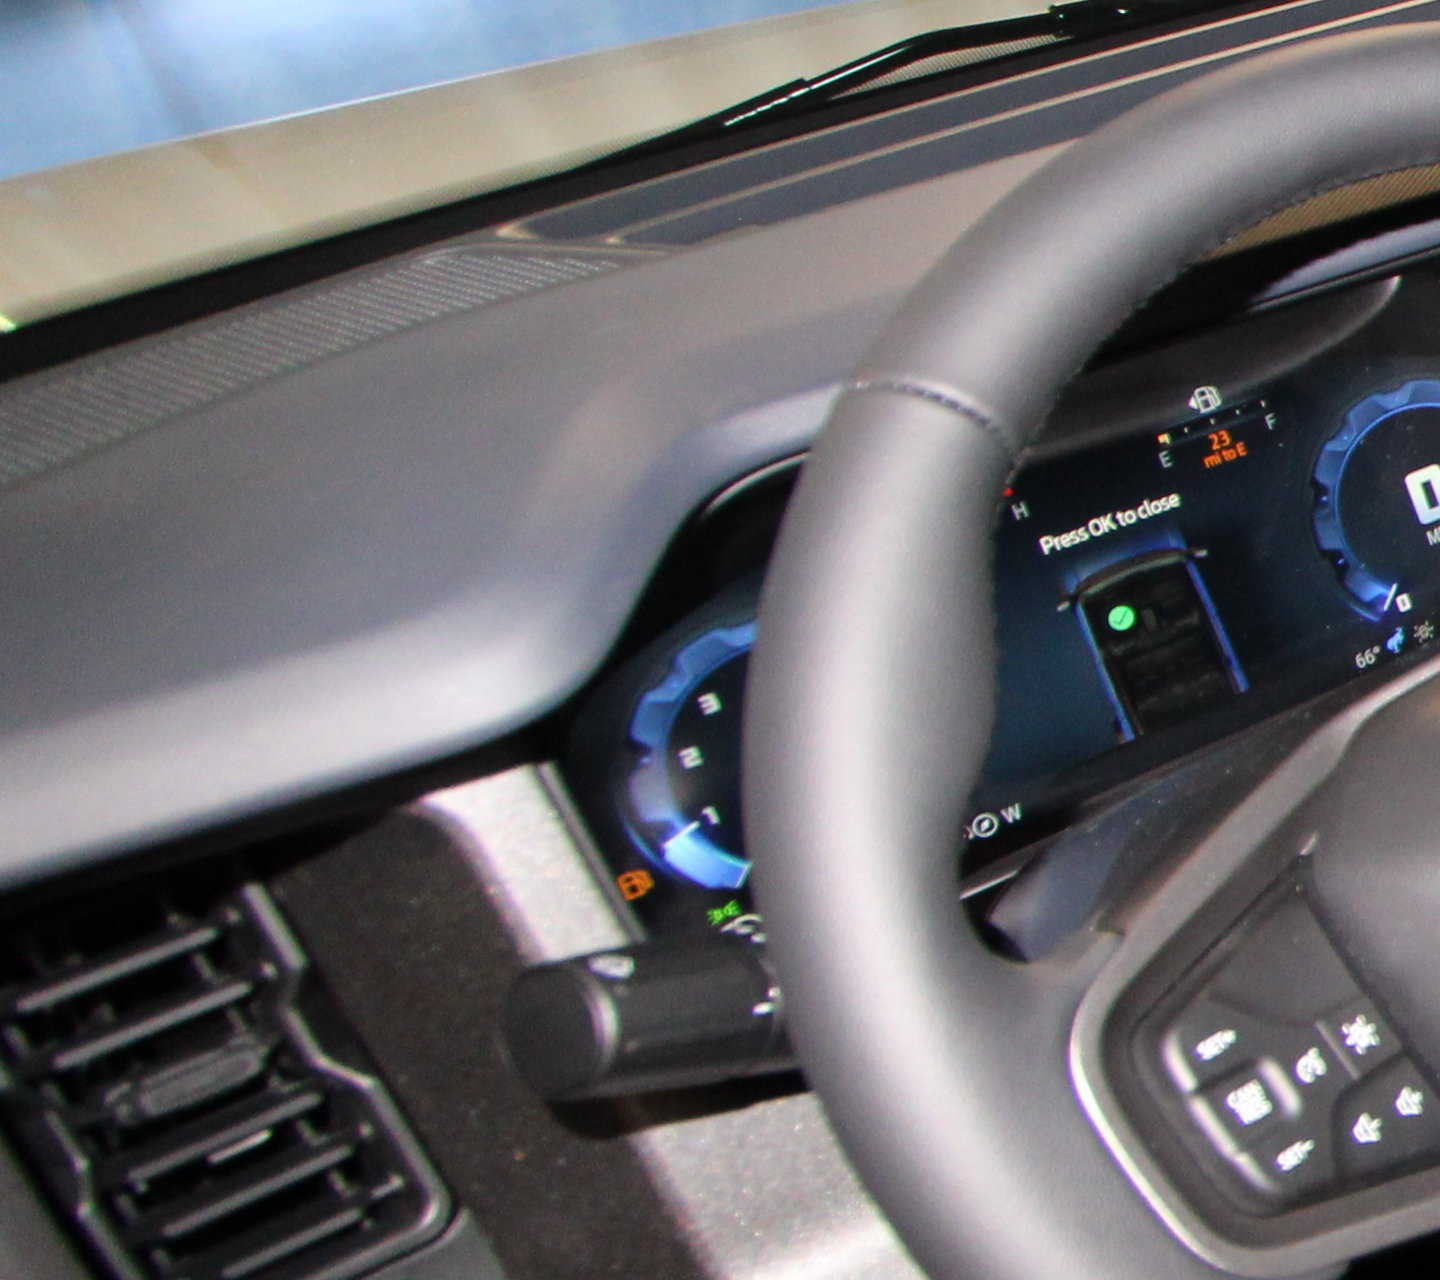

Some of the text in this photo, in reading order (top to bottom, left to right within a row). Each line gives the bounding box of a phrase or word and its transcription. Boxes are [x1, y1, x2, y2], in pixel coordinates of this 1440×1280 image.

[1263, 412, 1276, 431] F
[1207, 429, 1233, 452] 23
[1157, 449, 1173, 469] E
[1203, 440, 1249, 469] mi to E
[1011, 500, 1030, 521] H
[1038, 492, 1182, 556] Press OK to close
[1395, 592, 1412, 613] 0
[1355, 644, 1381, 669] 66°
[698, 691, 723, 717] 3
[678, 745, 704, 770] 2
[702, 805, 721, 826] 1
[1000, 802, 1022, 825] W
